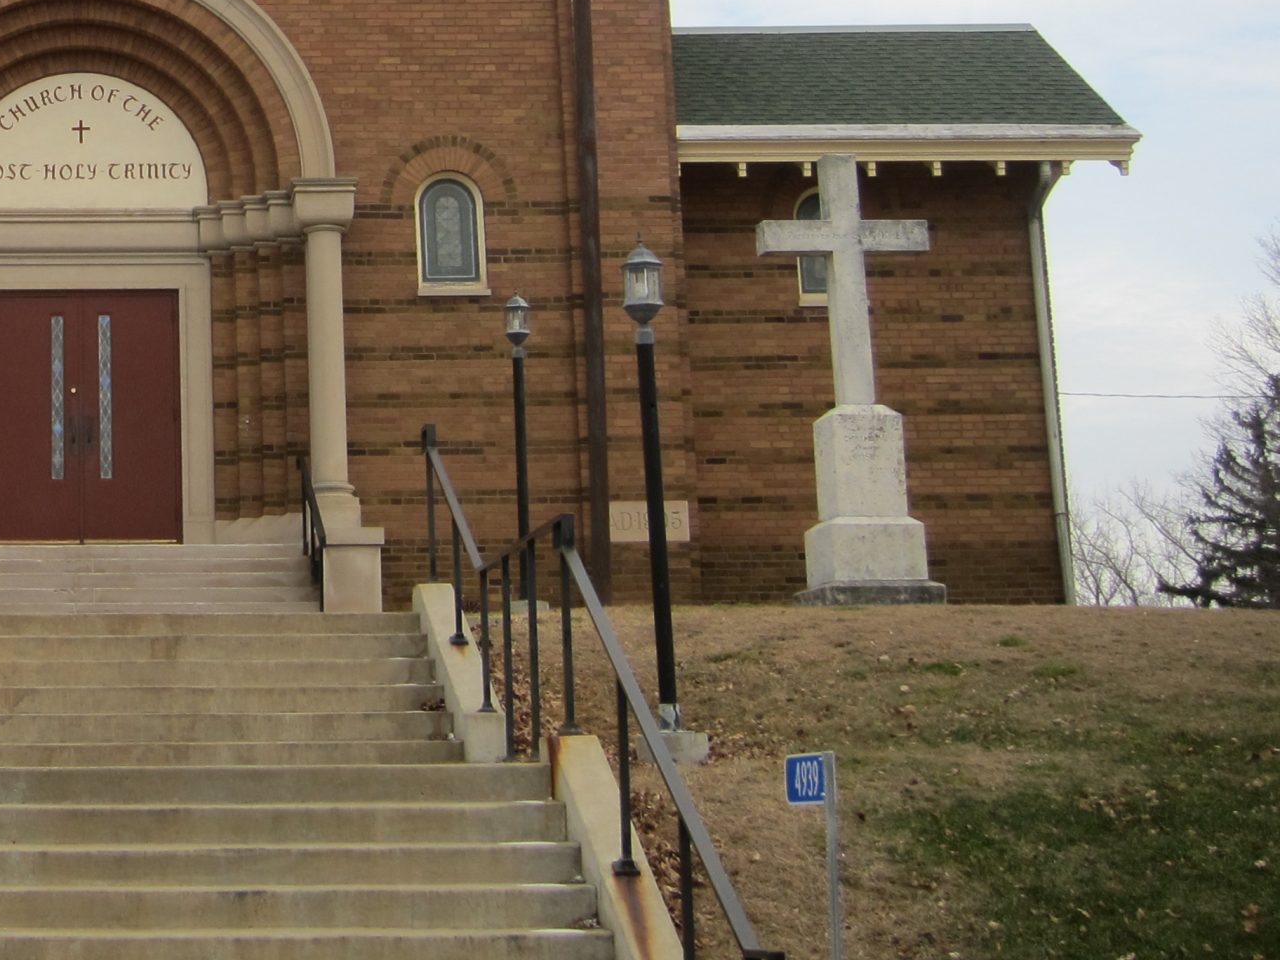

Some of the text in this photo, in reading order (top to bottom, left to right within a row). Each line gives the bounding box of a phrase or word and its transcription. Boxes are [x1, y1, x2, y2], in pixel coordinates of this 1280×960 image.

[90, 84, 121, 104] OF
[122, 95, 165, 132] THE
[42, 163, 98, 180] HOLY
[107, 162, 193, 180] TRINITY
[794, 760, 819, 797] 4939
